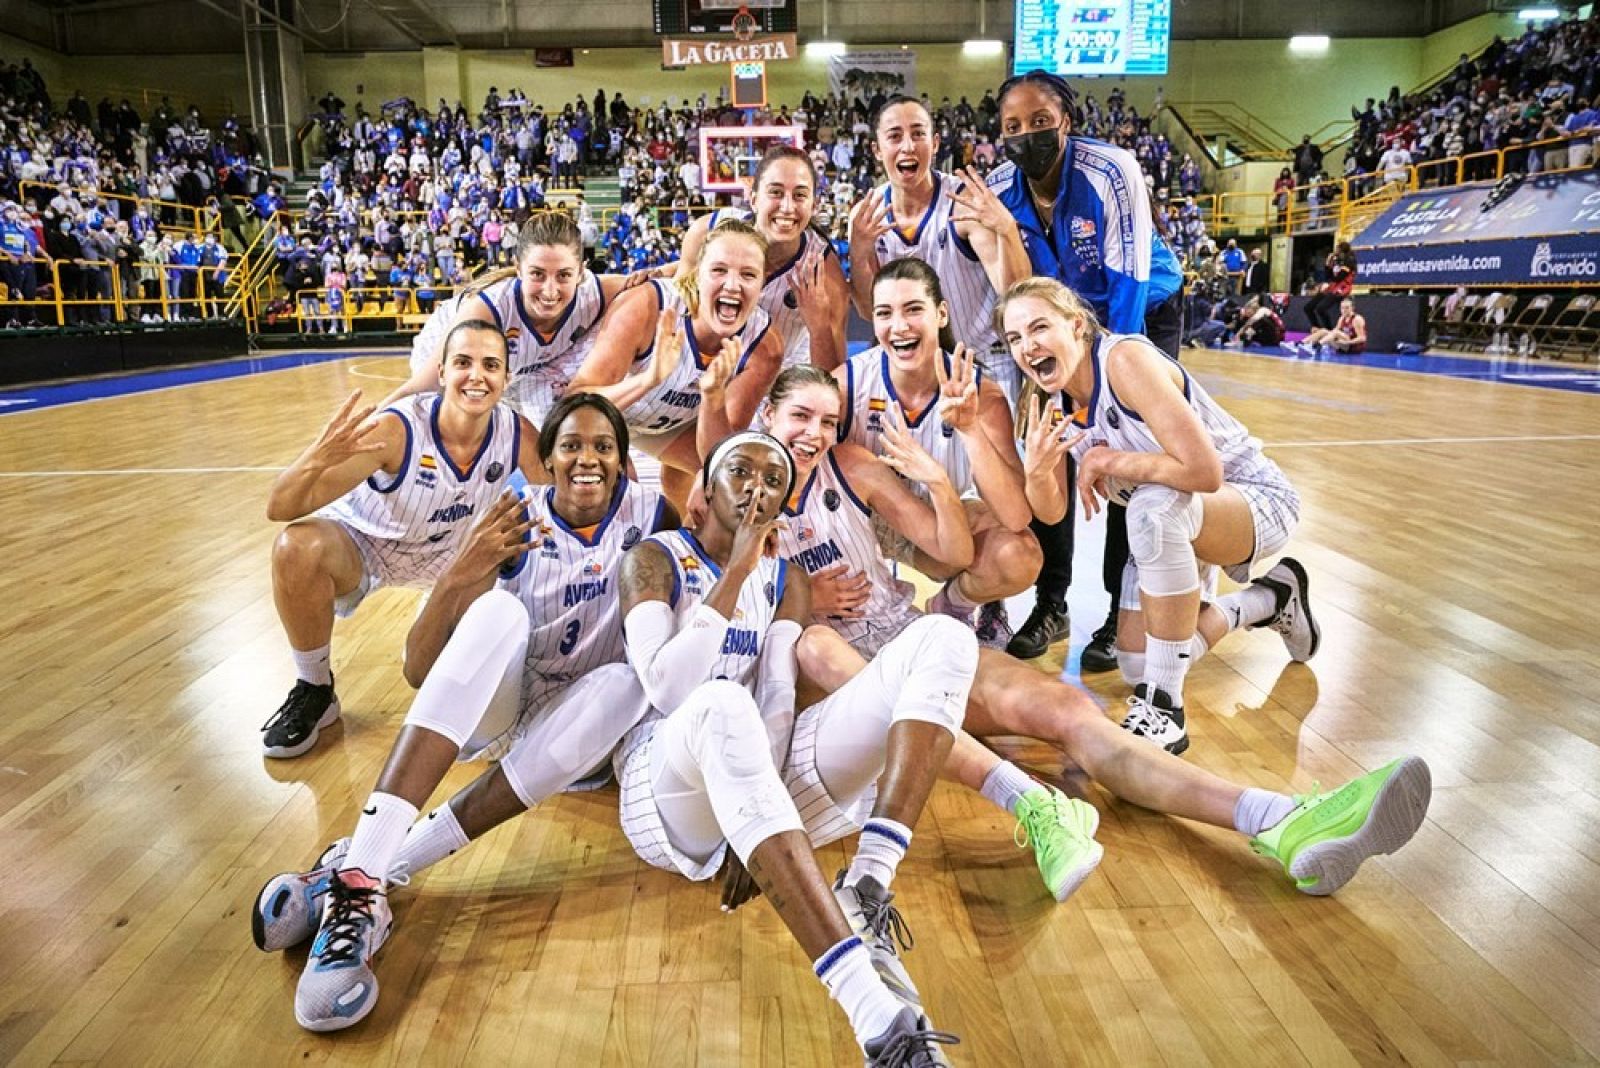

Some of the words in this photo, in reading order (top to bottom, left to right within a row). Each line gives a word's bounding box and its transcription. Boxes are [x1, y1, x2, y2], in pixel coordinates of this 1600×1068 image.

[671, 41, 702, 65] LA
[703, 41, 790, 63] GACETA
[1391, 206, 1461, 225] CASTILLA
[559, 618, 580, 656] 3
[721, 627, 758, 656] ENIDA
